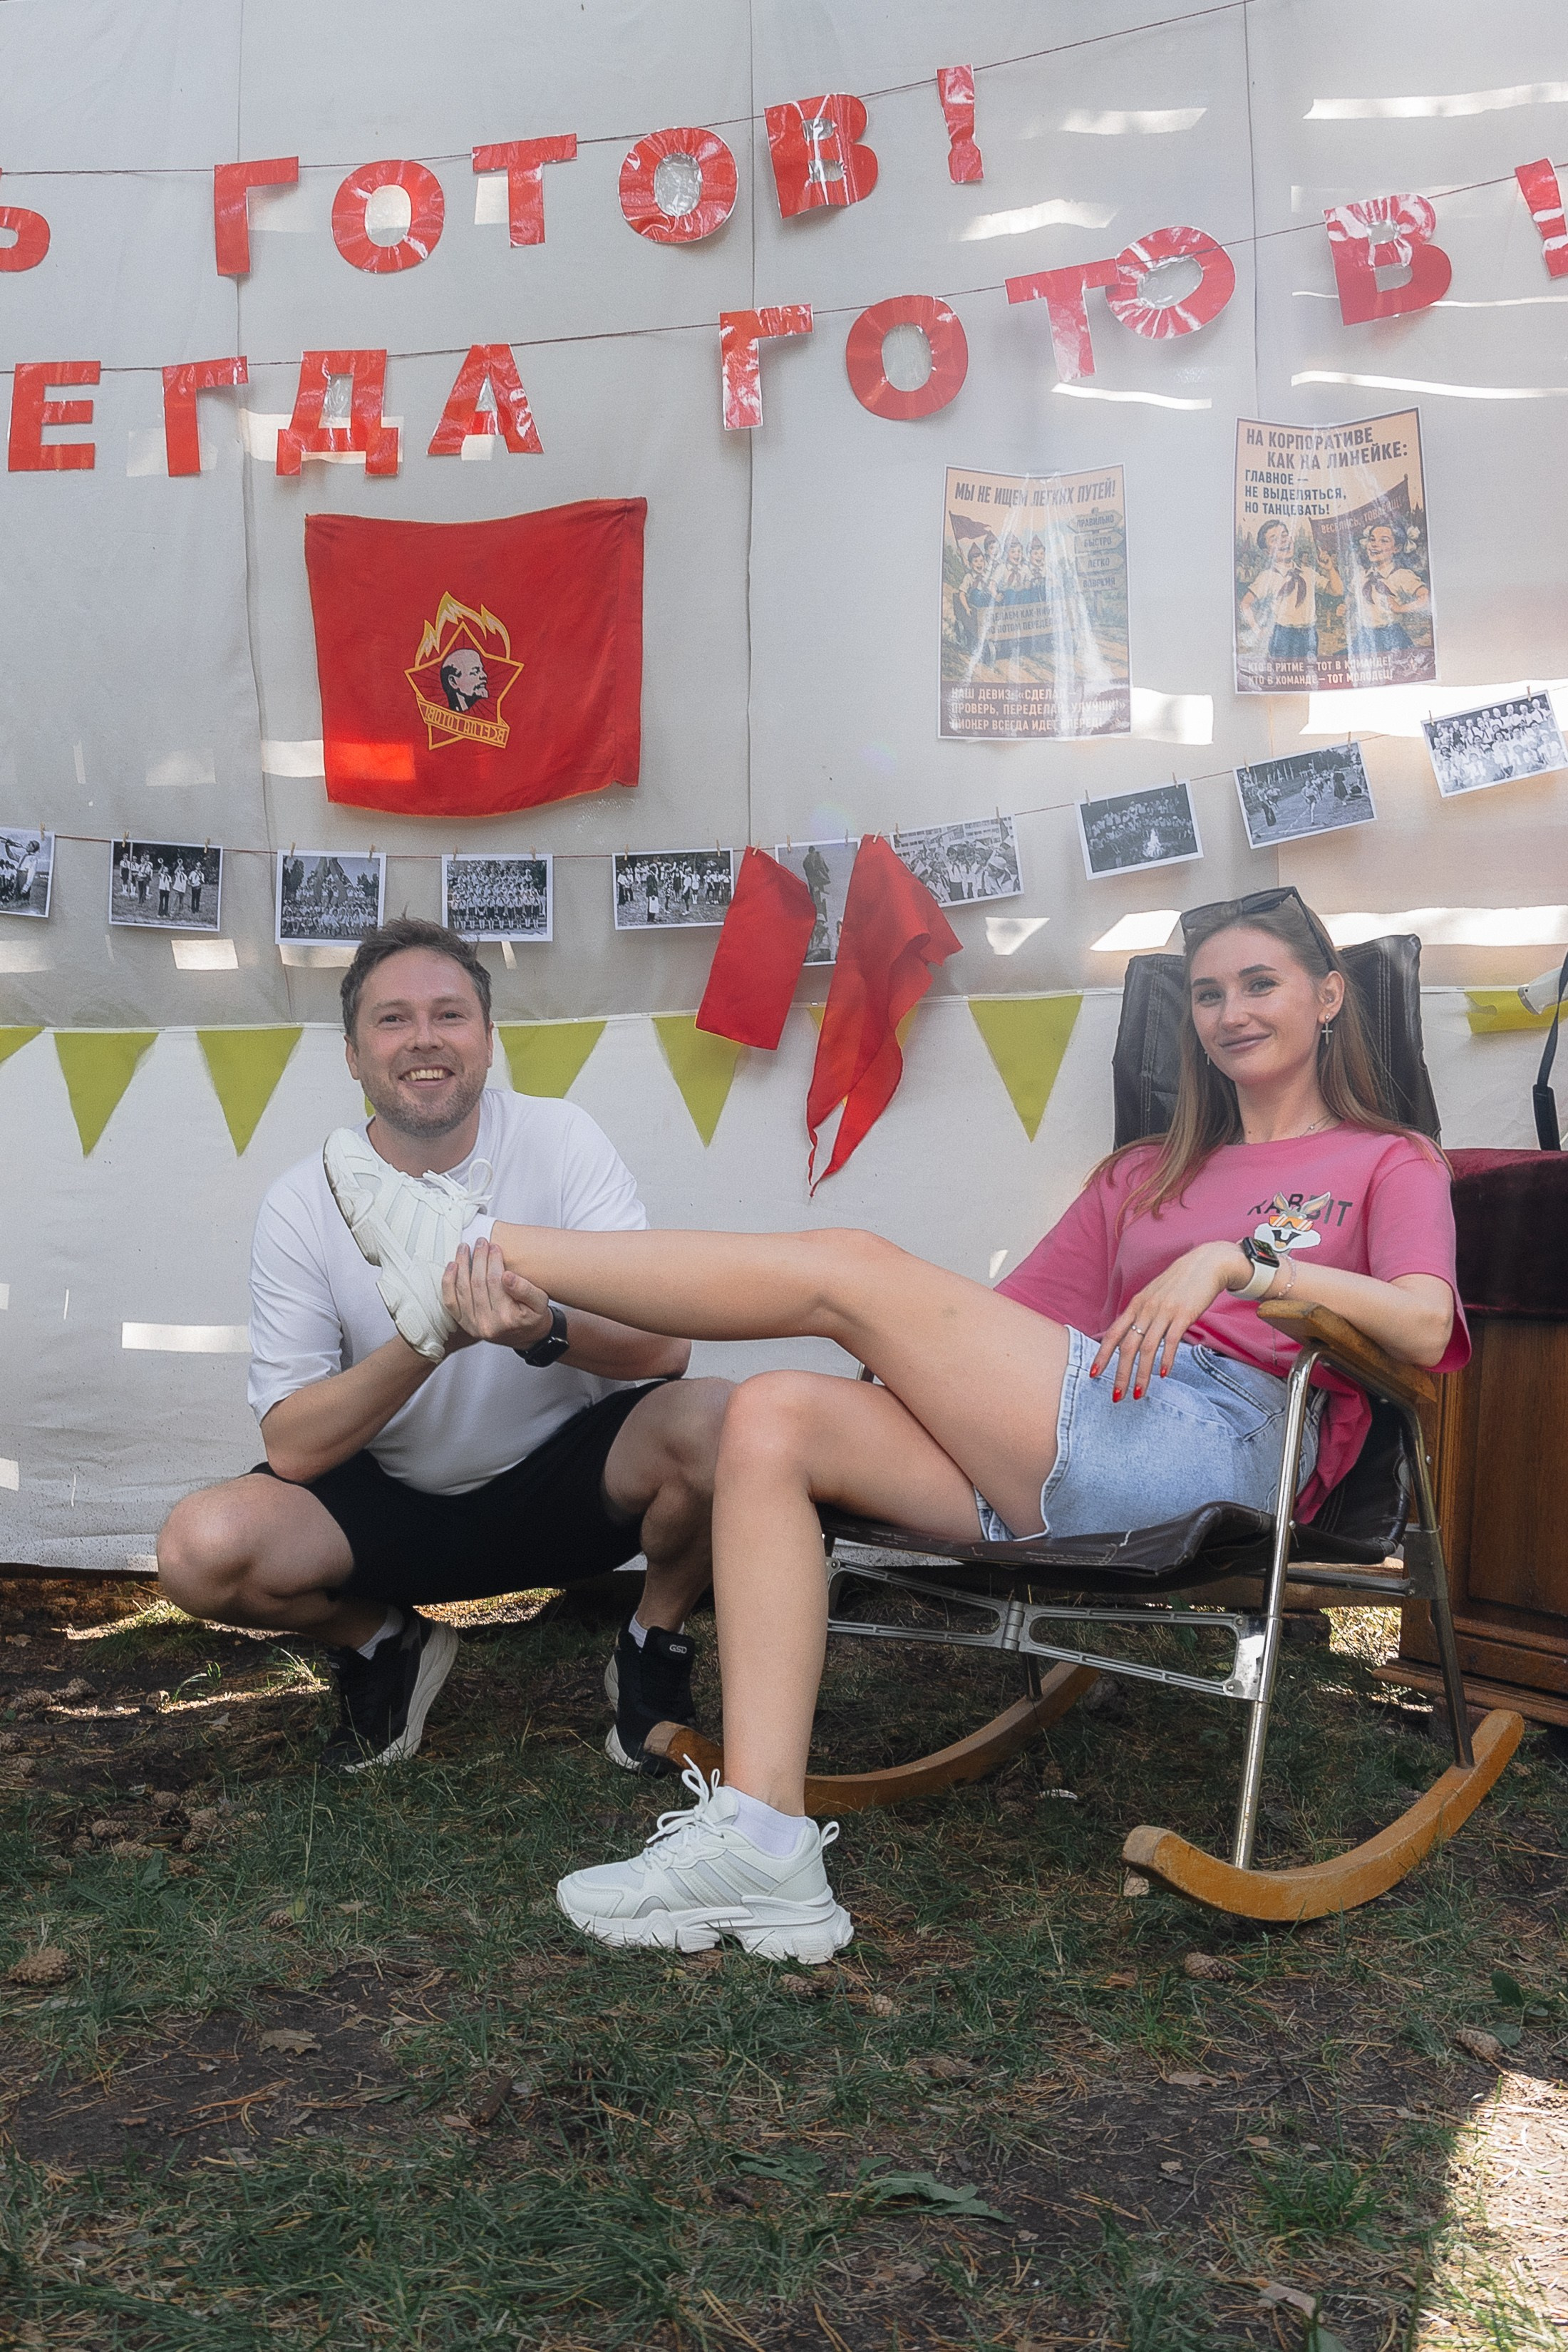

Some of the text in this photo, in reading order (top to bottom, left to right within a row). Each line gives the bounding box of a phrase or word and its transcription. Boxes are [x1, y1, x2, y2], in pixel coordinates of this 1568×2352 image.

[214, 63, 984, 276] ГОТОВ!
[9, 343, 544, 477] ЕГДА
[1247, 426, 1373, 450] НА КОРПОРАТИВЕ
[1267, 440, 1408, 470] КАК НА ЛИНЕЙКЕ:
[1245, 469, 1294, 485] ГЛАВНОЕ
[955, 478, 1115, 507] МЫ НЕ ИЩЕМ ЛЕГКИХ ПУТЕЙ!
[1245, 485, 1346, 502] НЕ ВЫДЕЛЯТЬСЯ,
[1244, 502, 1330, 517] НО ТАНЦЕВАТЬ!
[1077, 514, 1114, 527] ПРАВИЛЬНО
[1084, 536, 1112, 547] БЫСТРО
[1088, 557, 1110, 567] ЛЕГКО
[1275, 661, 1304, 672] РИТМЕ
[1316, 660, 1332, 671] ТОТ
[1335, 660, 1341, 670] В
[1248, 675, 1264, 685] КТО
[1267, 675, 1274, 685] В
[1276, 674, 1319, 686] КОМАНДЕ
[1326, 673, 1343, 684] ТОТ
[1346, 669, 1394, 683] МОЛОДЕЦ!
[951, 687, 974, 699] НАШ
[951, 702, 999, 715] ПРОВЕРЬ,
[951, 718, 989, 731] ПИОНЕР
[991, 718, 1028, 731] ВСЕГДА
